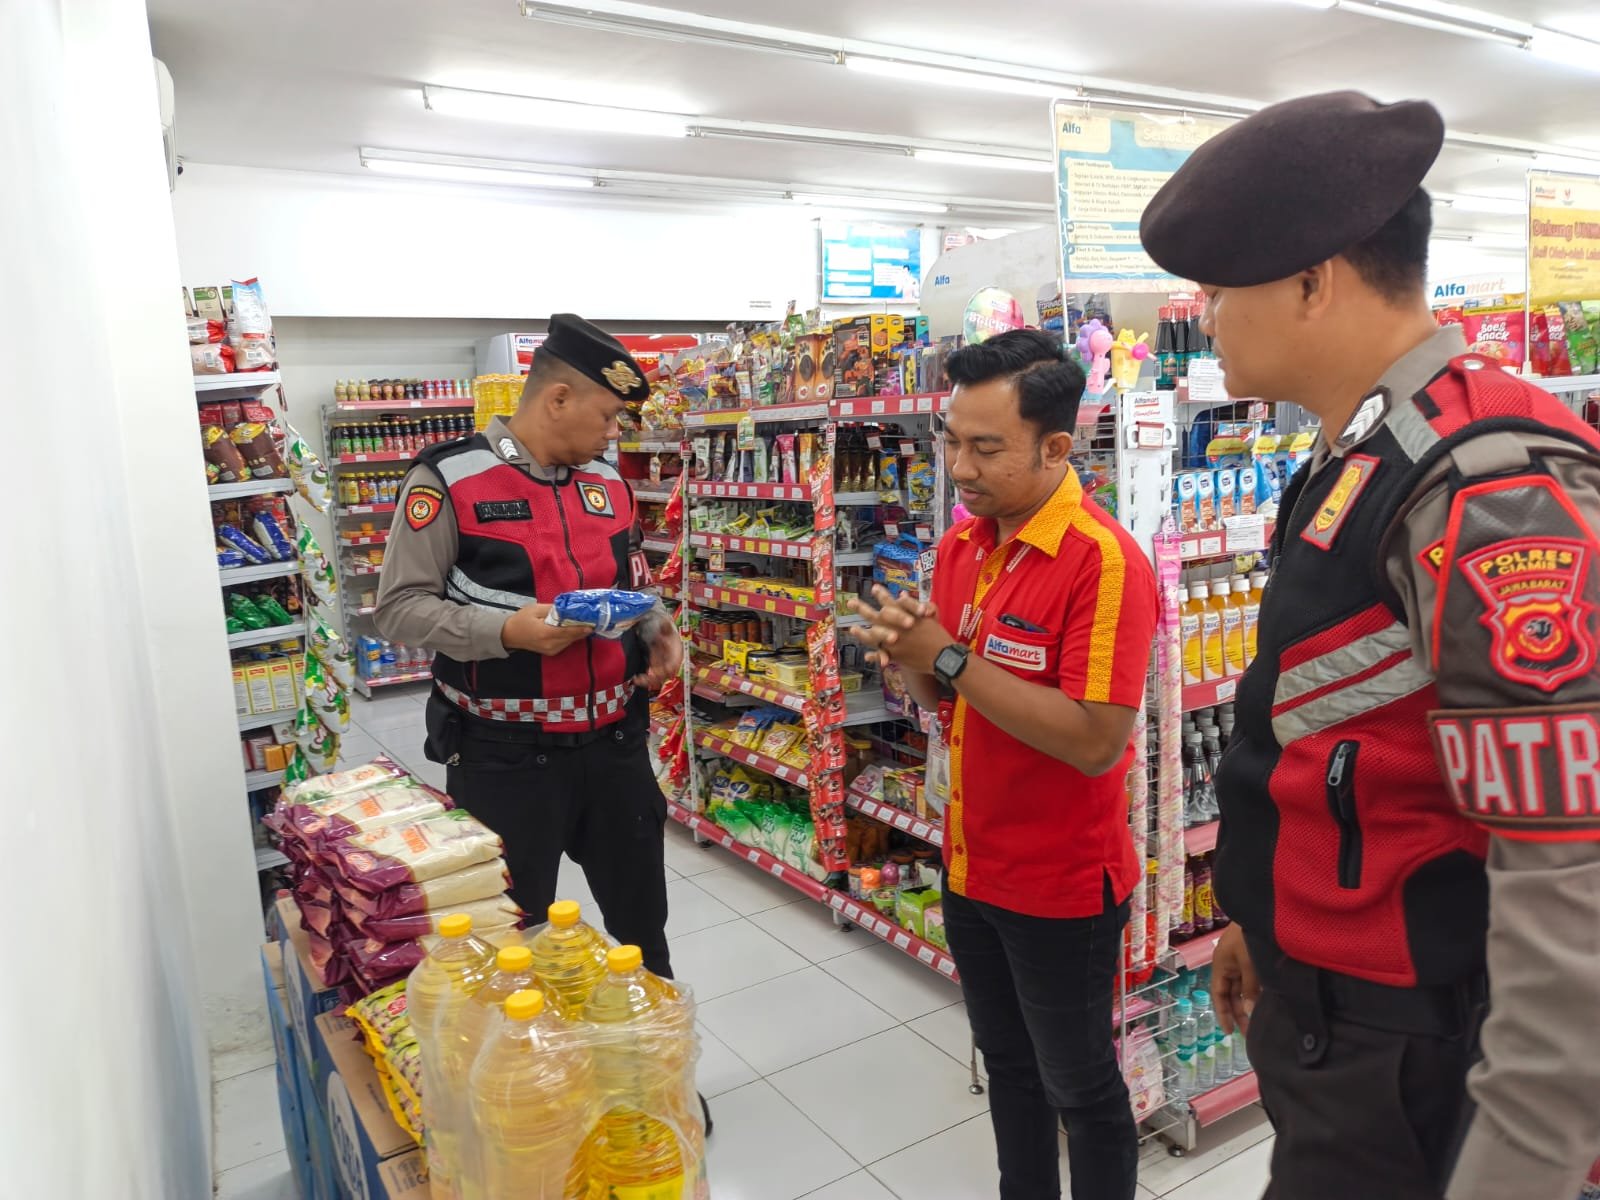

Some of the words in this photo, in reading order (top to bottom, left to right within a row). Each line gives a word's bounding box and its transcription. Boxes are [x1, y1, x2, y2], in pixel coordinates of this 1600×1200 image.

[1062, 122, 1081, 135] Alfa
[935, 275, 950, 286] Alfa
[1434, 278, 1506, 298] Alfamart
[1476, 331, 1509, 342] Snack
[1480, 549, 1573, 574] POLRES
[1498, 560, 1557, 575] CIAMIS
[987, 637, 1041, 661] Alfamart
